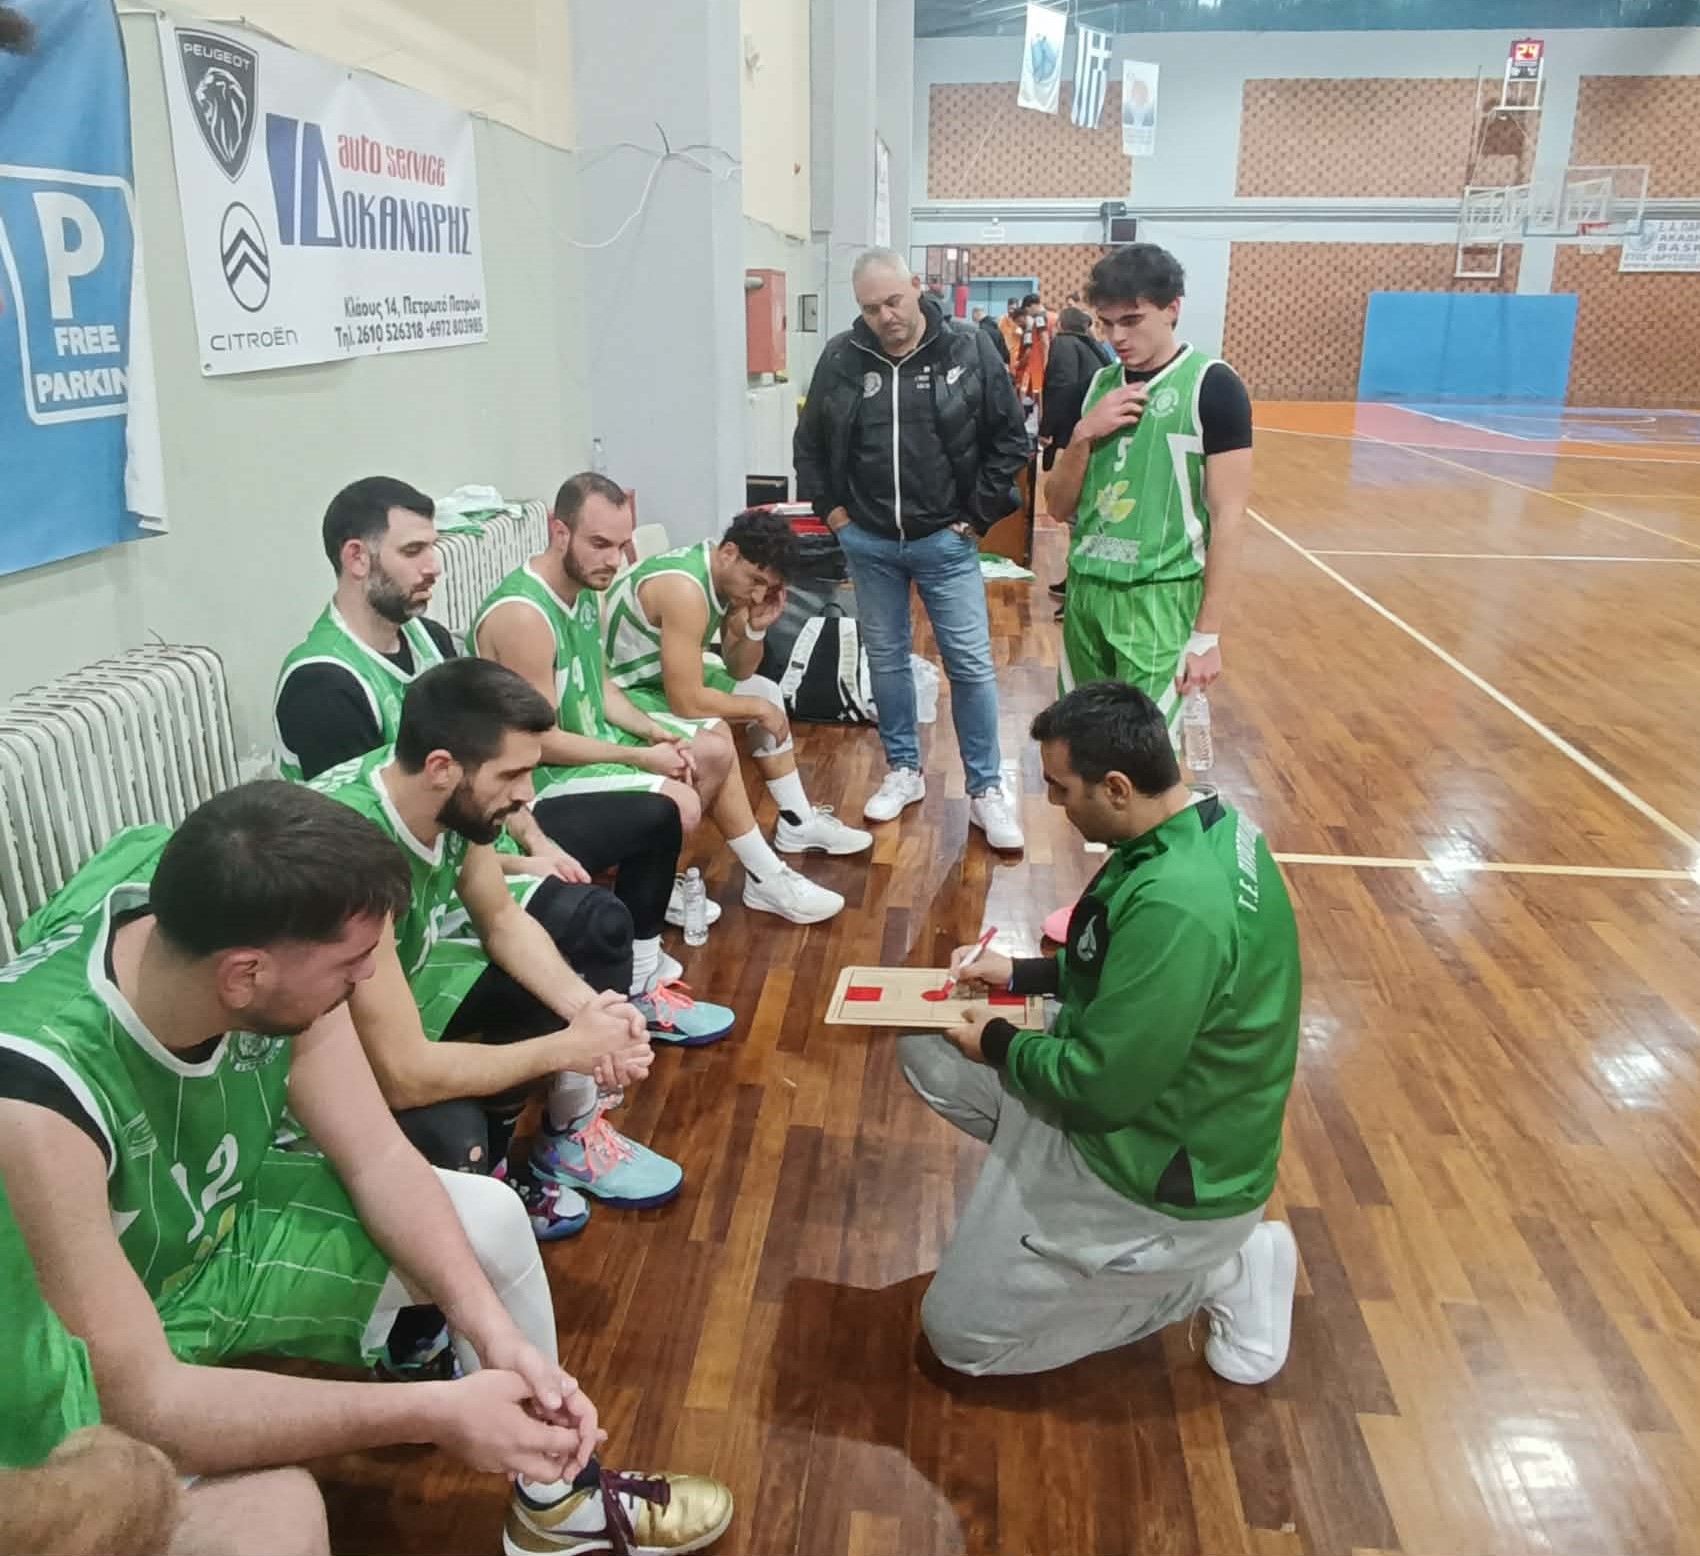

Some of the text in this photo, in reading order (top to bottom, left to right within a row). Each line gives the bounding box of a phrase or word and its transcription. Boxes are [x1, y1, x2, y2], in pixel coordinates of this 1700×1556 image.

[183, 43, 250, 70] PEUGEOT
[1515, 43, 1539, 60] 24
[338, 134, 446, 187] auto service
[32, 191, 105, 319] P
[385, 297, 401, 317] 14,
[54, 324, 121, 357] FREE
[357, 323, 384, 345] 2610
[386, 320, 424, 342] 526318
[169, 1132, 243, 1244] 12
